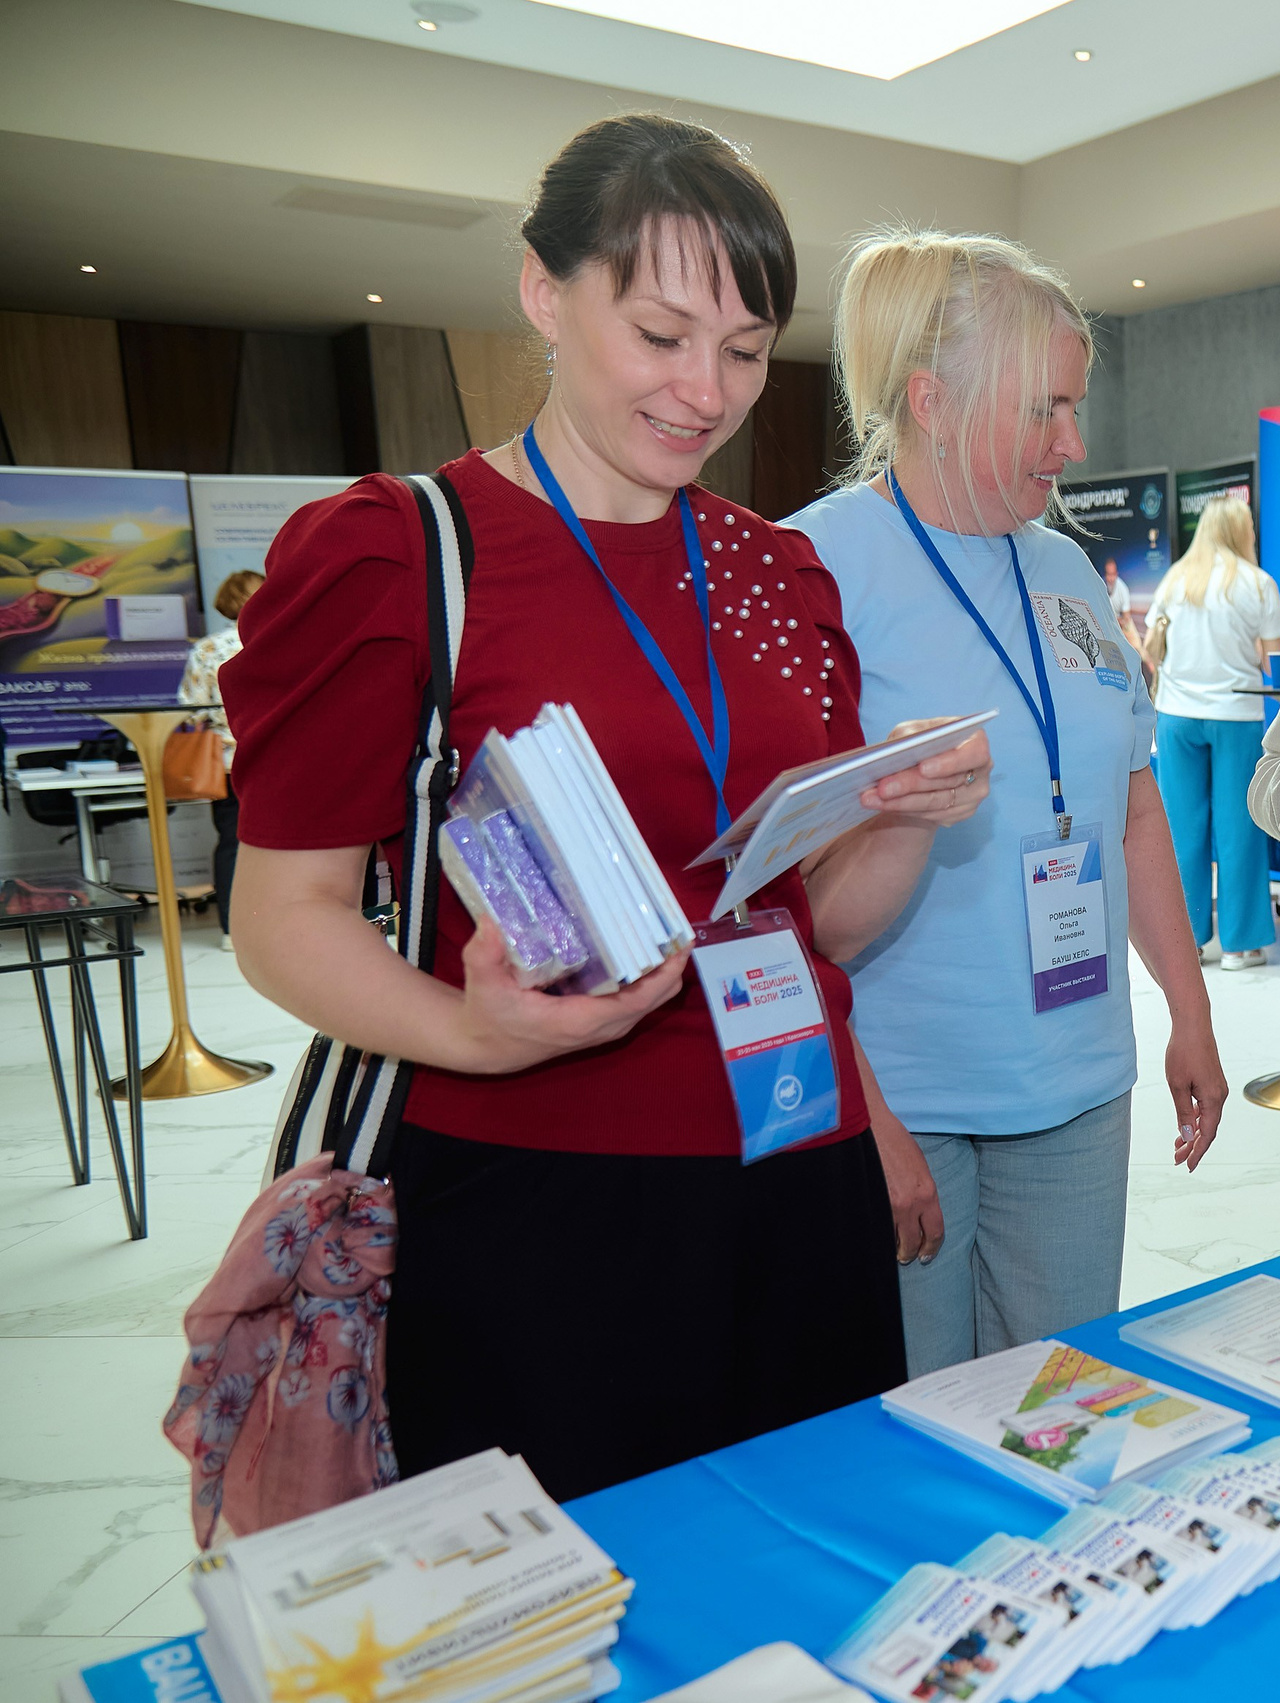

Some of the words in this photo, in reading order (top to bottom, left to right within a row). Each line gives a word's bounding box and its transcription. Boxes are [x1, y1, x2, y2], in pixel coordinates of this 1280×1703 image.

[1036, 600, 1057, 638] OCEANIA
[1061, 657, 1078, 668] 20
[1049, 863, 1076, 874] МЕДИЦИНА
[1064, 870, 1077, 879] 2025
[1049, 907, 1087, 921] РОМАНОВА
[1059, 920, 1079, 931] Ольга
[1054, 930, 1085, 942] Ивановна
[1051, 954, 1072, 966] БАУШ
[1072, 949, 1090, 961] ХЕЛС
[750, 973, 799, 993] МЕДИЦИНА
[1049, 980, 1072, 992] УЧАСТНИК
[1072, 974, 1096, 986] ВЫСТАВКИ
[753, 991, 780, 1006] БОЛИ
[780, 984, 803, 1000] 2025
